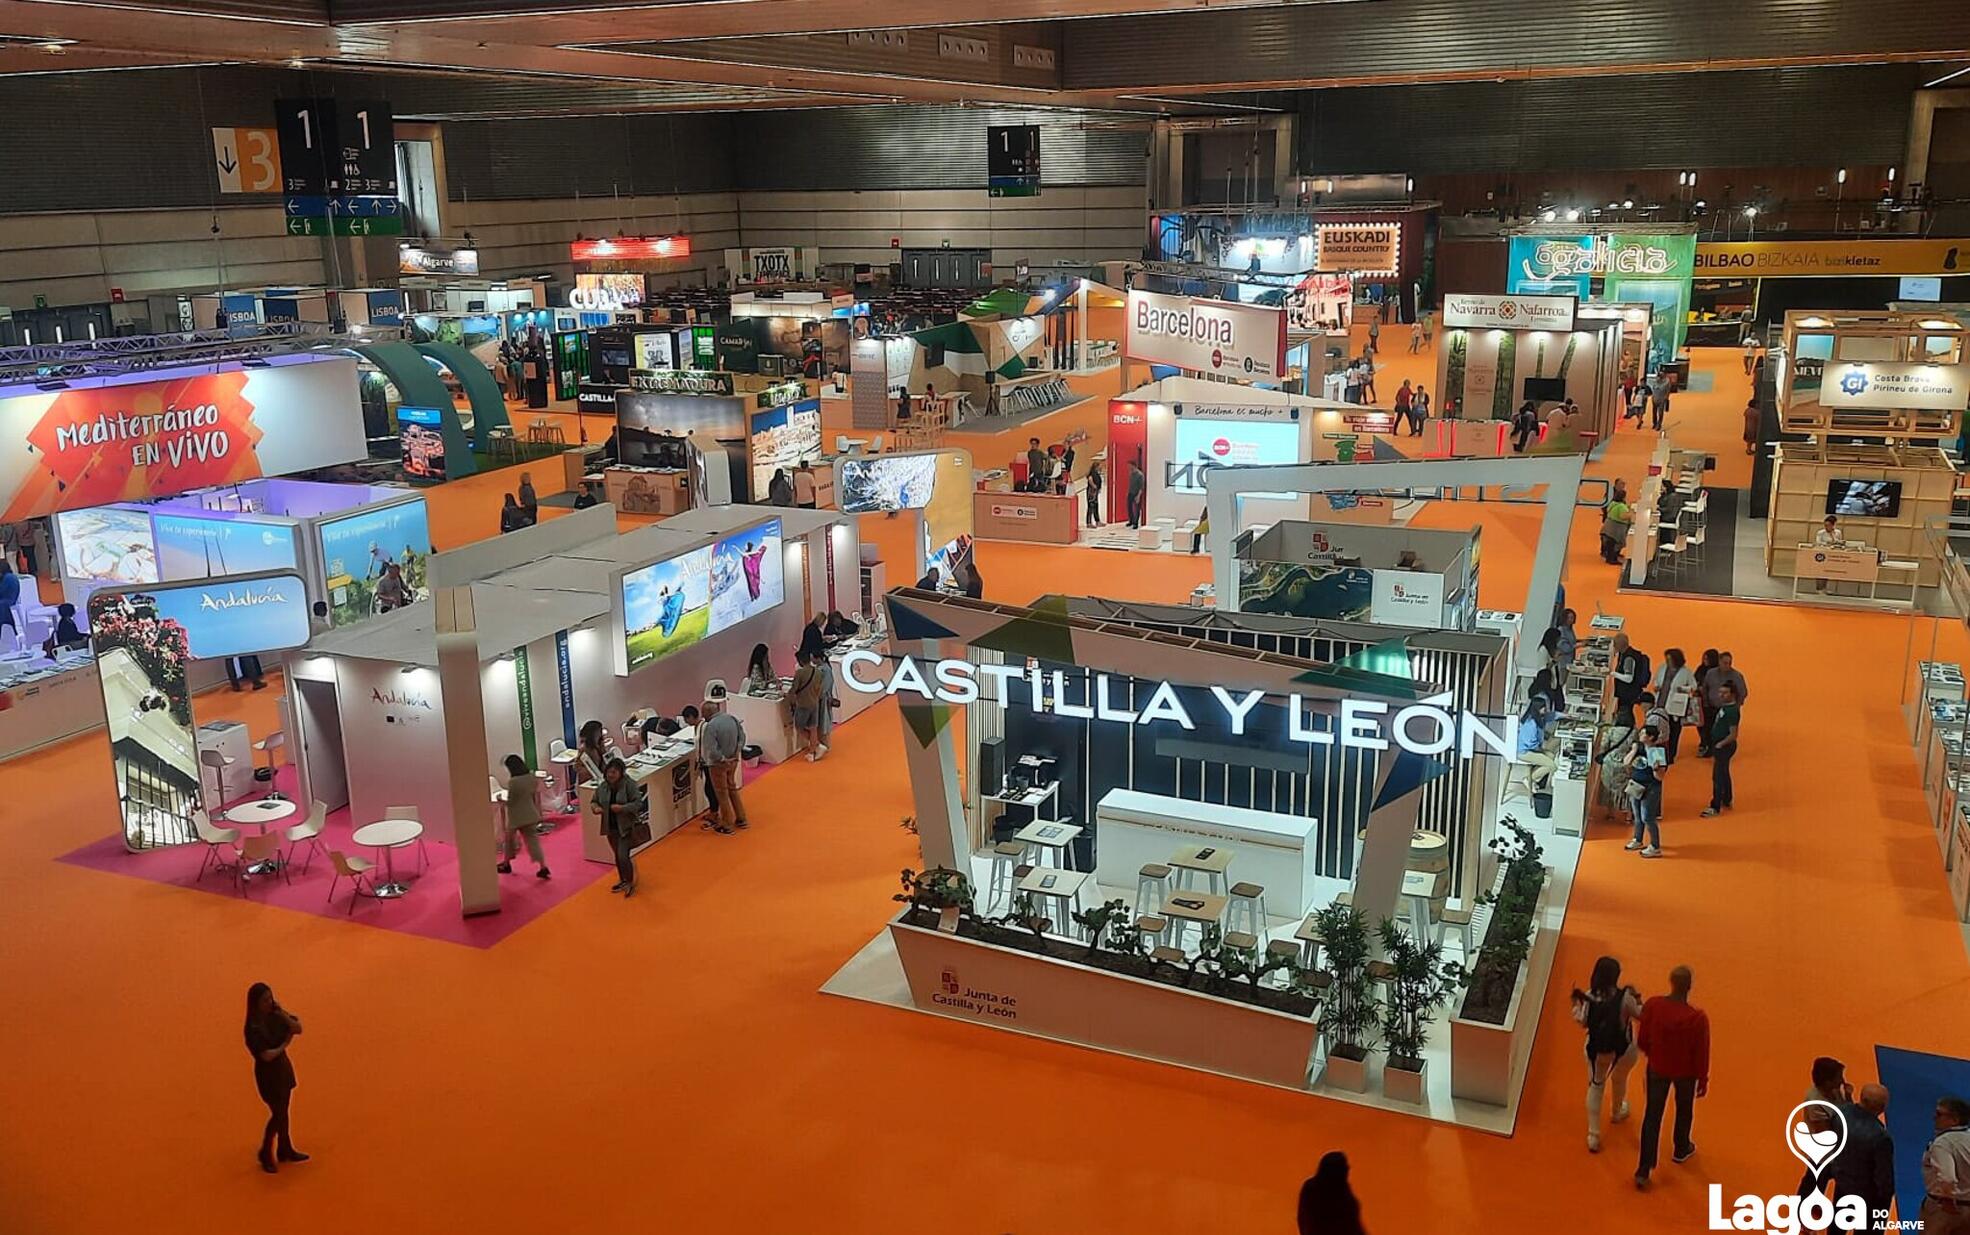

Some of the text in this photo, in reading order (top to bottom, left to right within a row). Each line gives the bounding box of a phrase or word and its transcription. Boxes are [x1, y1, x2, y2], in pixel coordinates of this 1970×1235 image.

[297, 109, 312, 149] 1
[356, 110, 371, 150] 1
[1000, 131, 1009, 152] 1
[247, 131, 276, 191] 3
[1324, 231, 1390, 243] EUSKADI
[423, 256, 454, 268] Algarve
[754, 255, 789, 274] TXOTX
[1694, 254, 1754, 267] BILBAO
[1757, 252, 1819, 267] BIZKAIA
[371, 306, 399, 318] LISBOA
[1450, 302, 1565, 317] Navarra Nafarroa
[1137, 301, 1231, 344] Barcelona
[630, 376, 727, 392] EXTREMADURA
[1874, 374, 1900, 383] Costa
[1873, 384, 1905, 394] Pirineu
[1923, 385, 1953, 395] Girona
[1113, 414, 1143, 425] BCN+
[1194, 405, 1233, 416] Barcelona
[57, 402, 219, 452] Mediterráneo
[132, 443, 160, 468] EN
[200, 585, 288, 612] Andalucía
[841, 649, 1519, 764] CASTILLA Y LEÓN
[932, 993, 1017, 1019] Castilla y León
[965, 988, 1016, 1006] Junta de
